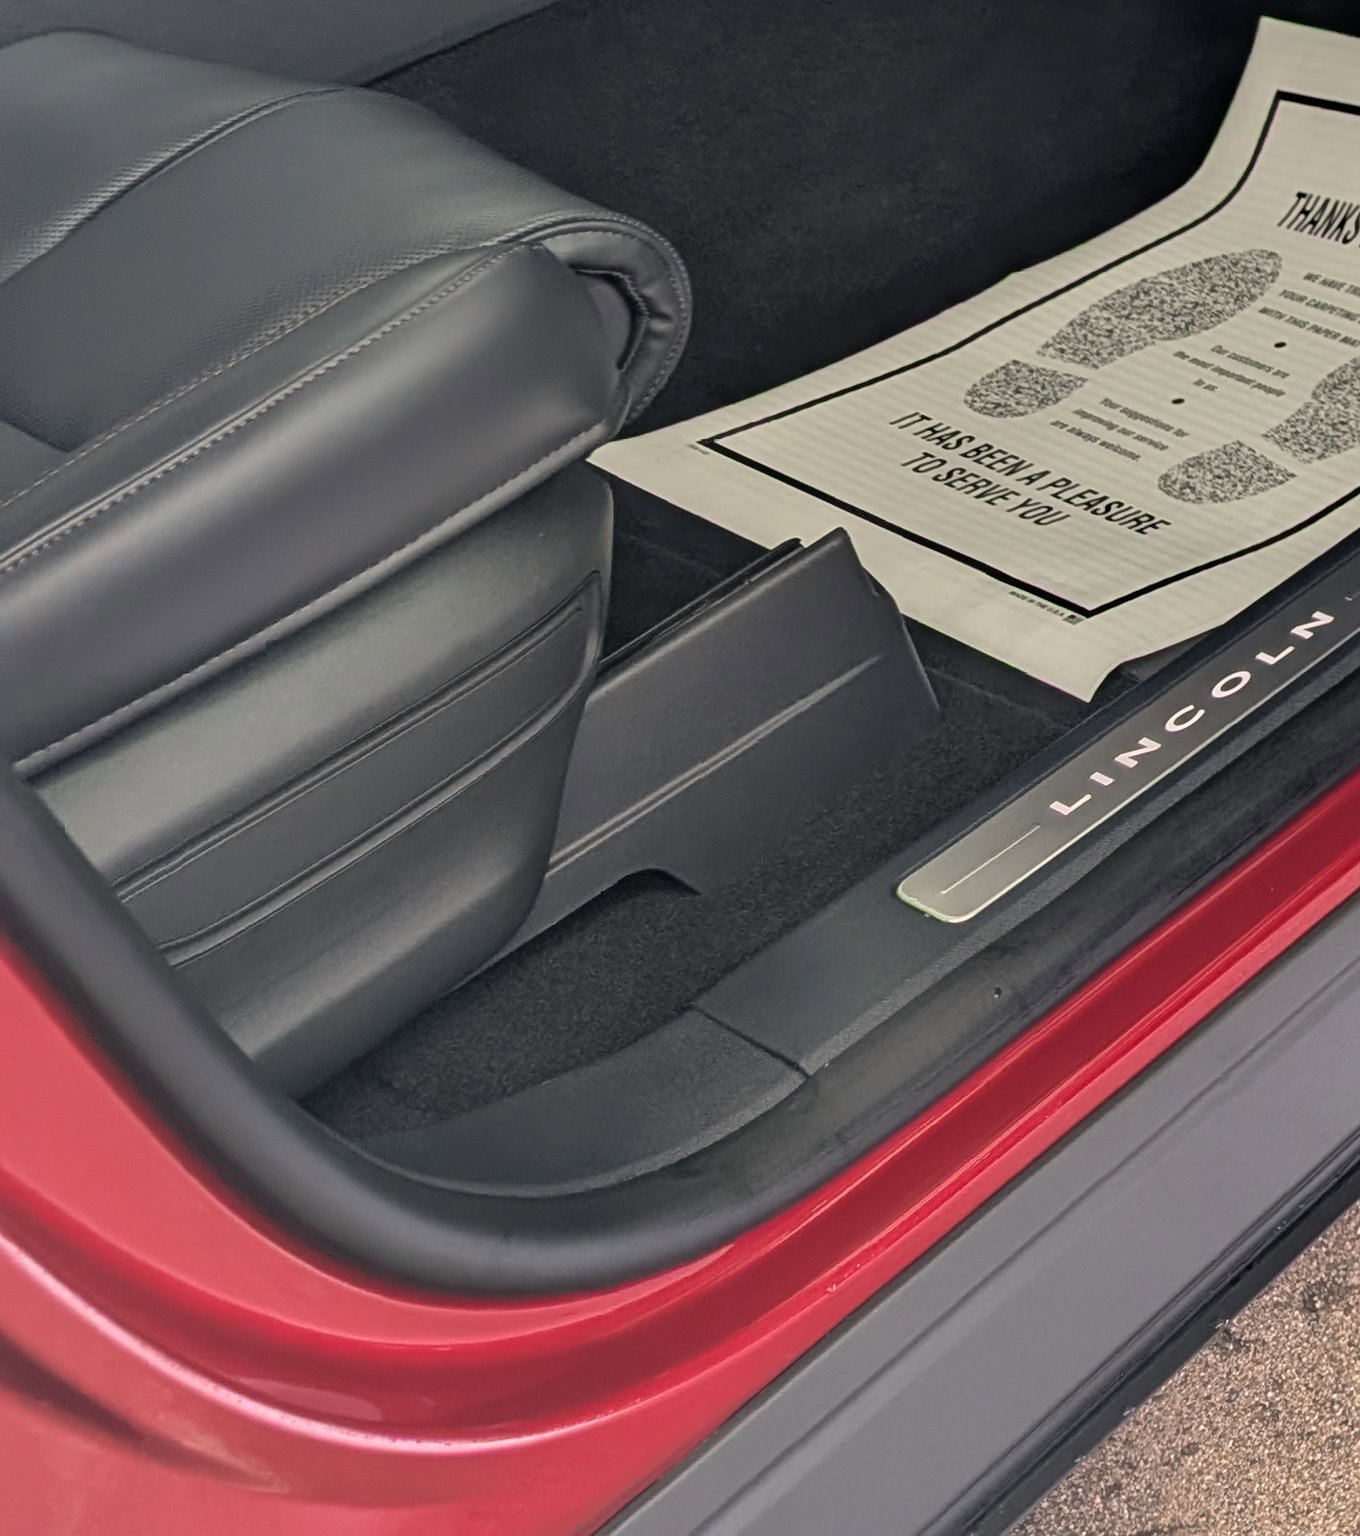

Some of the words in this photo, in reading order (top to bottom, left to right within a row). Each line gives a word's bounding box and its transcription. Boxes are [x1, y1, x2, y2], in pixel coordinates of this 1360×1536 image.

[1303, 272, 1322, 283] WE
[1319, 277, 1347, 291] HAVE
[1279, 289, 1308, 303] YOUR
[1305, 298, 1360, 321] CARPETING
[1258, 306, 1287, 320] WITH
[1285, 315, 1310, 329] THIS
[1307, 324, 1341, 340] PAPER
[1173, 350, 1190, 360] the
[1188, 357, 1214, 369] most
[1211, 365, 1257, 385] important
[1251, 382, 1286, 397] people
[1211, 344, 1229, 355] Our
[1227, 352, 1274, 372] customers
[1272, 369, 1290, 379] are
[1050, 420, 1069, 430] are
[1067, 427, 1101, 443] always
[1072, 408, 1120, 431] improving
[1133, 434, 1169, 451] service
[1100, 397, 1122, 409] Your
[1119, 407, 1175, 432] suggestions
[889, 412, 931, 429] IT
[913, 422, 975, 451] HAS
[959, 443, 1034, 477] BEEN
[1016, 469, 1051, 486] A
[1037, 477, 1172, 535] PLEASURE
[901, 452, 948, 474] TO
[932, 467, 1020, 506] SERVE
[1006, 498, 1071, 526] YOU
[1050, 611, 1334, 815] LINCOLN
